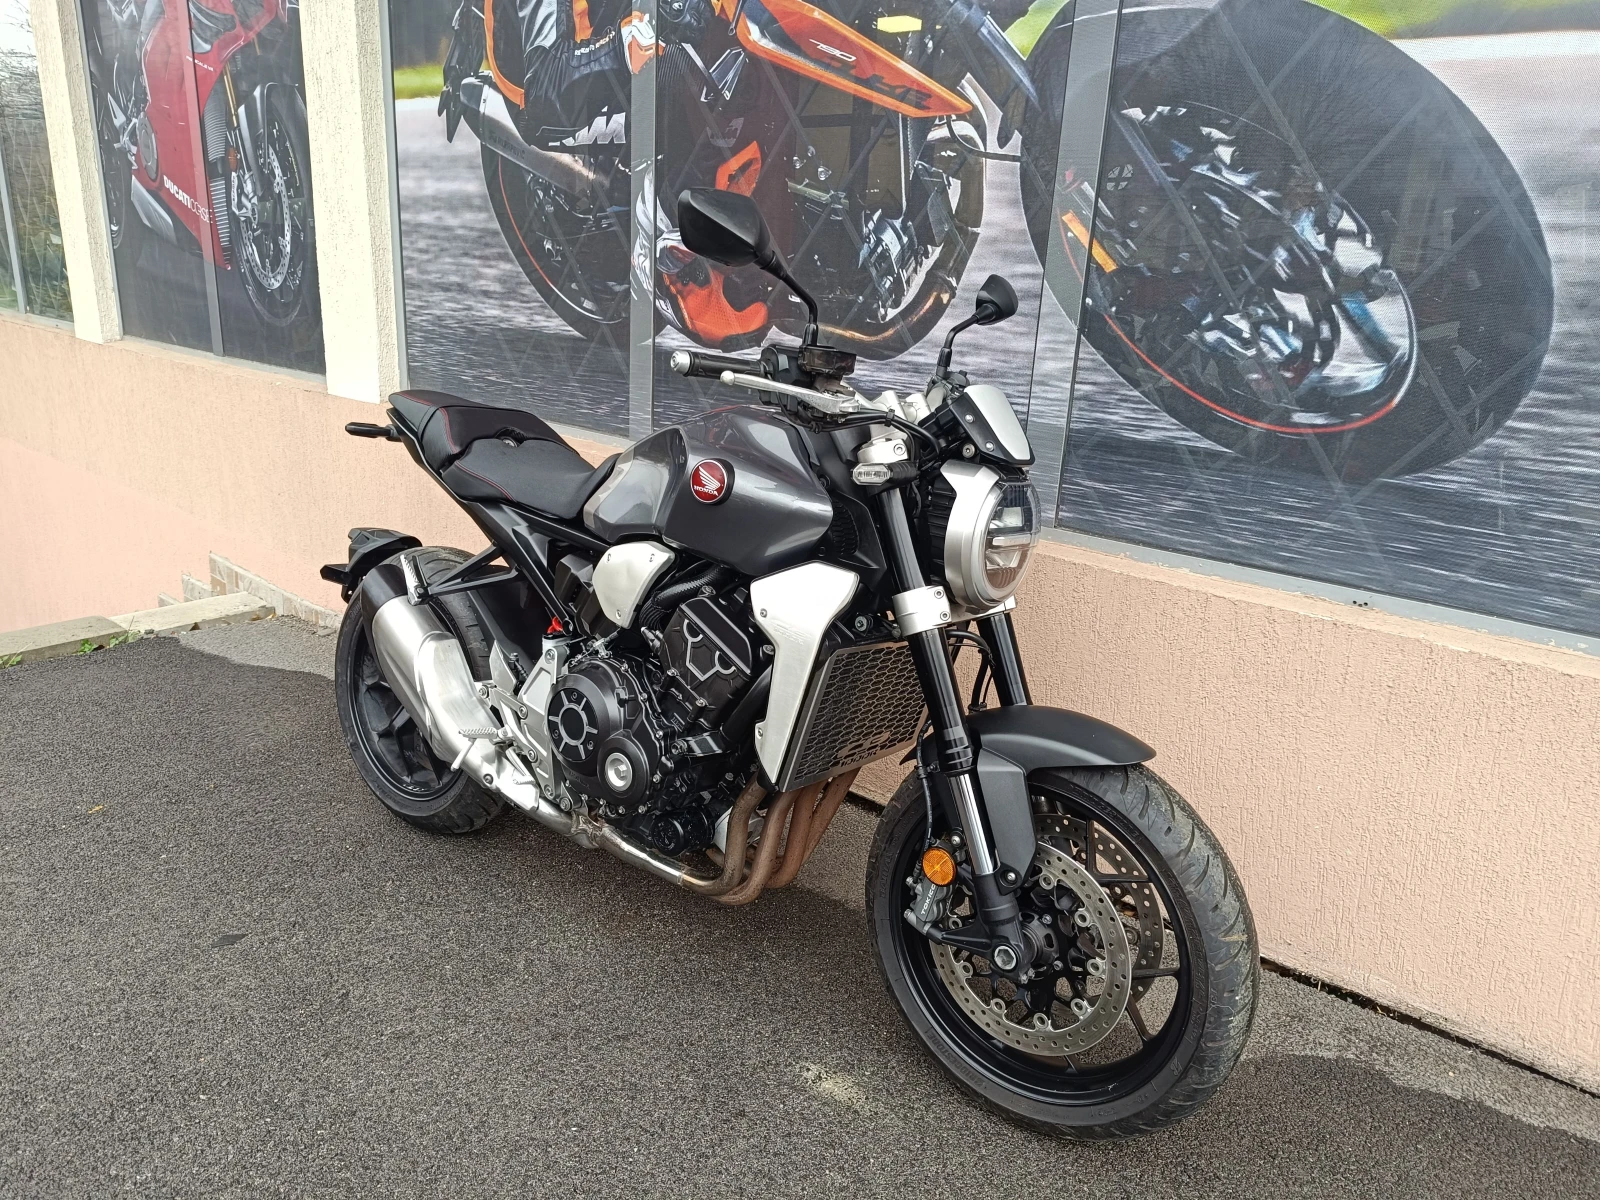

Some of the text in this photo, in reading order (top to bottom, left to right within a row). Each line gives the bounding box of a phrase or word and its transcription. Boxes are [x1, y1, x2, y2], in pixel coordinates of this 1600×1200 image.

[163, 174, 191, 209] DUCATI
[693, 484, 719, 497] HONDA
[920, 883, 936, 915] TOKICO
[926, 1030, 986, 1089] BRIDGESTONE
